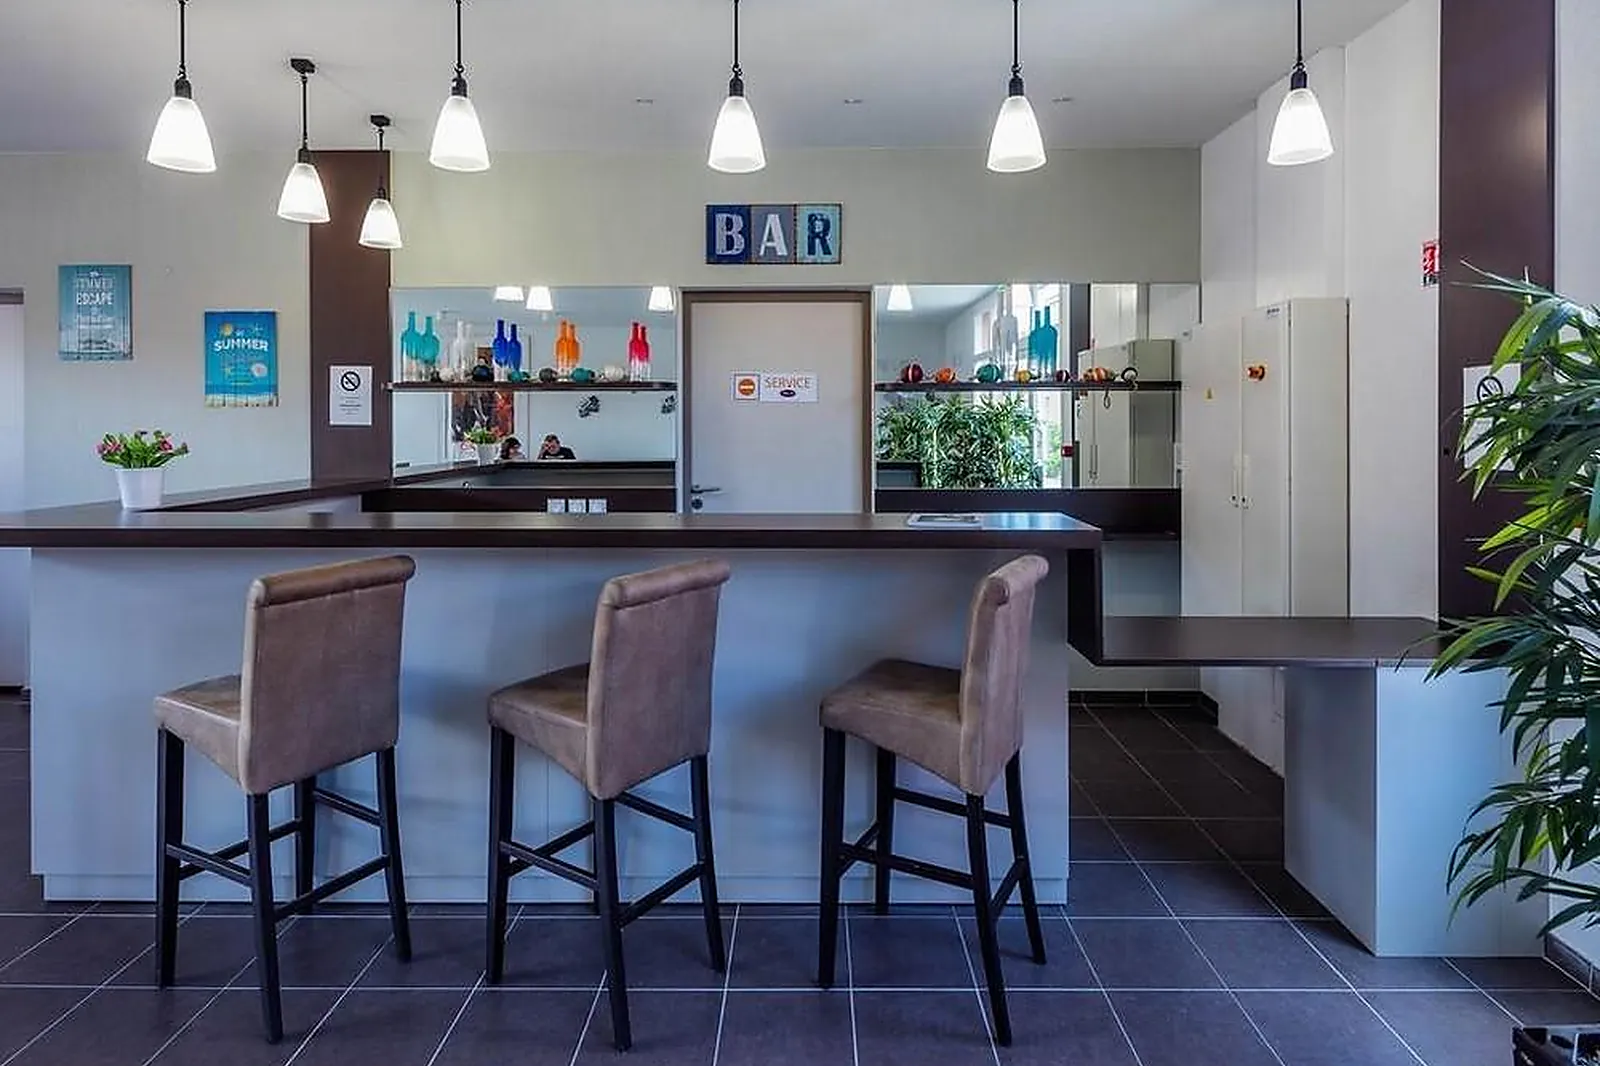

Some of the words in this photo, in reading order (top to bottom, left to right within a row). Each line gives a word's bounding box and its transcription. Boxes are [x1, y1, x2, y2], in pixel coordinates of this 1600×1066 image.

[714, 213, 832, 256] BAR
[213, 338, 269, 353] SUMMER
[764, 375, 812, 389] SERVICE
